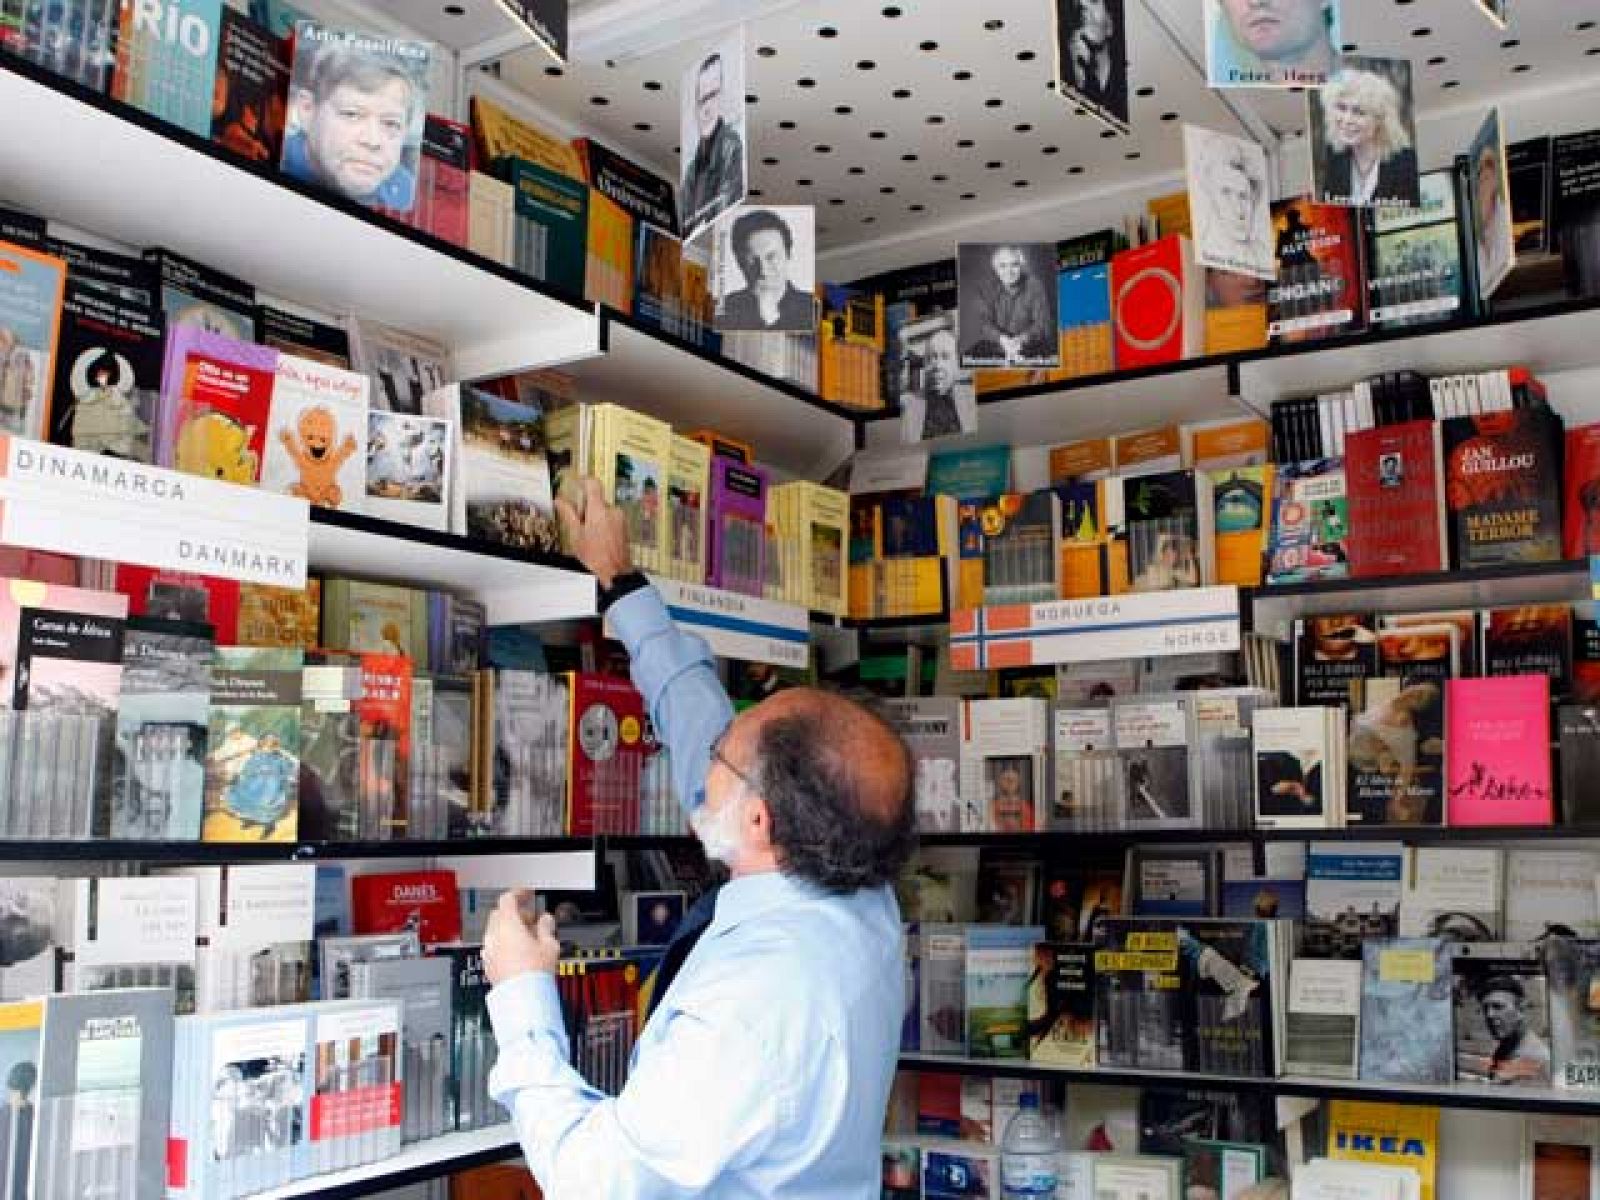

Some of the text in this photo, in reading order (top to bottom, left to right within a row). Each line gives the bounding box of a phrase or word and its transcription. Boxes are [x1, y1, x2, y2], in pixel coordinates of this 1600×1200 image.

[17, 450, 185, 500] DINAMARCA
[1461, 454, 1535, 475] GUILLOU
[179, 540, 297, 576] DANMARK
[1035, 603, 1120, 621] NORUEGA
[1164, 630, 1229, 647] NORGE
[1337, 1131, 1426, 1156] IKEA
